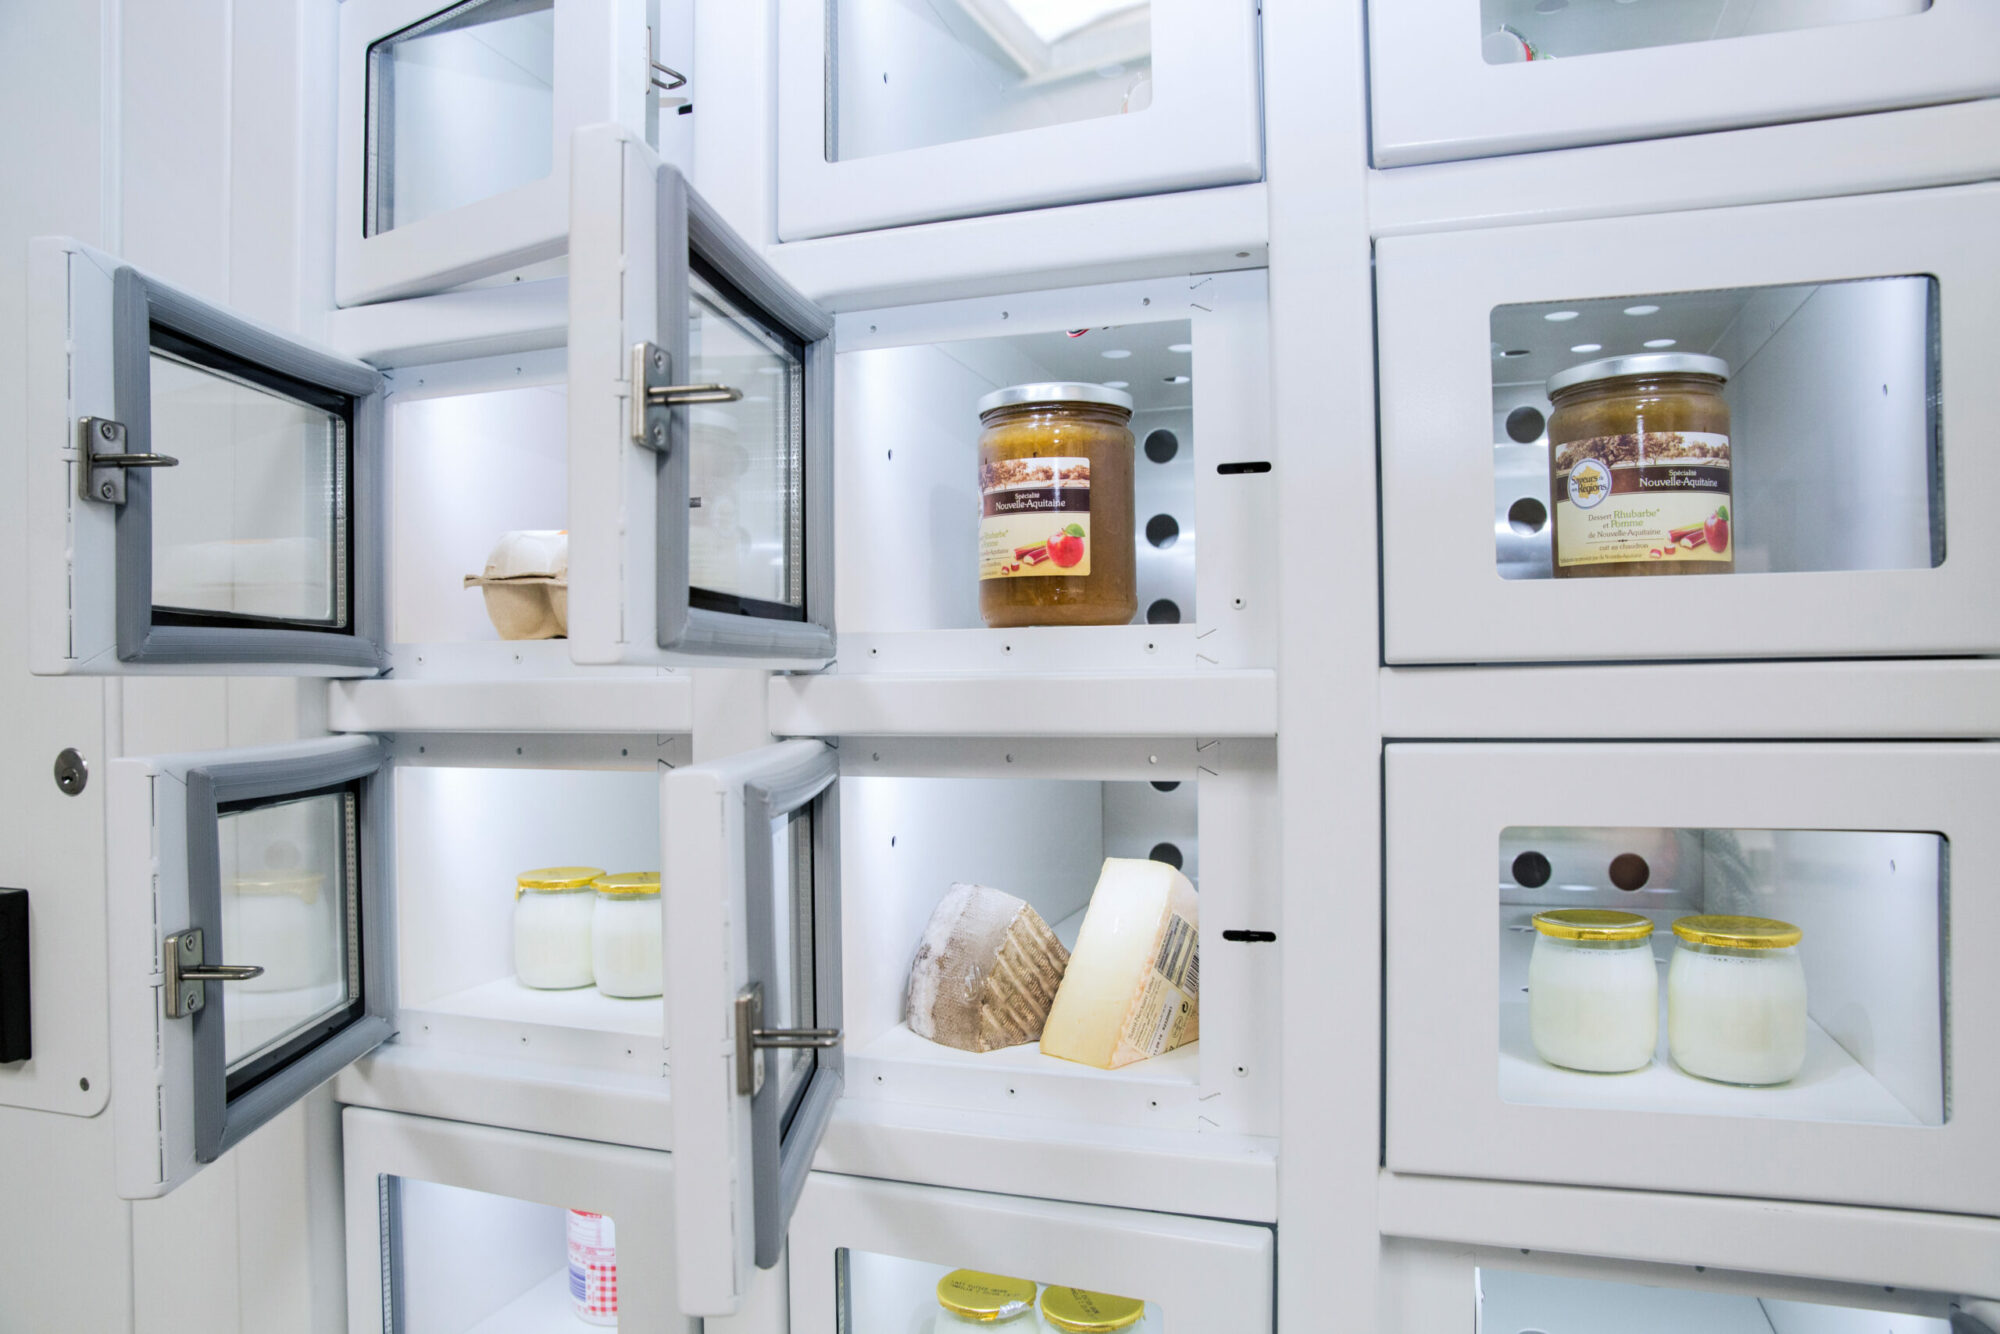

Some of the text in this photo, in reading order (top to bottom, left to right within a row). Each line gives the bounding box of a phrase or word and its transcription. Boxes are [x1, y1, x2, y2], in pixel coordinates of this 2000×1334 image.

[1639, 476, 1718, 488] Nouvelle-Aquitaine
[996, 499, 1066, 511] Nouvelle-Aquitaine
[1588, 513, 1612, 522] Dessert
[1610, 519, 1644, 529] Pomme
[1596, 528, 1661, 538] Nouvelle-Aquitaine
